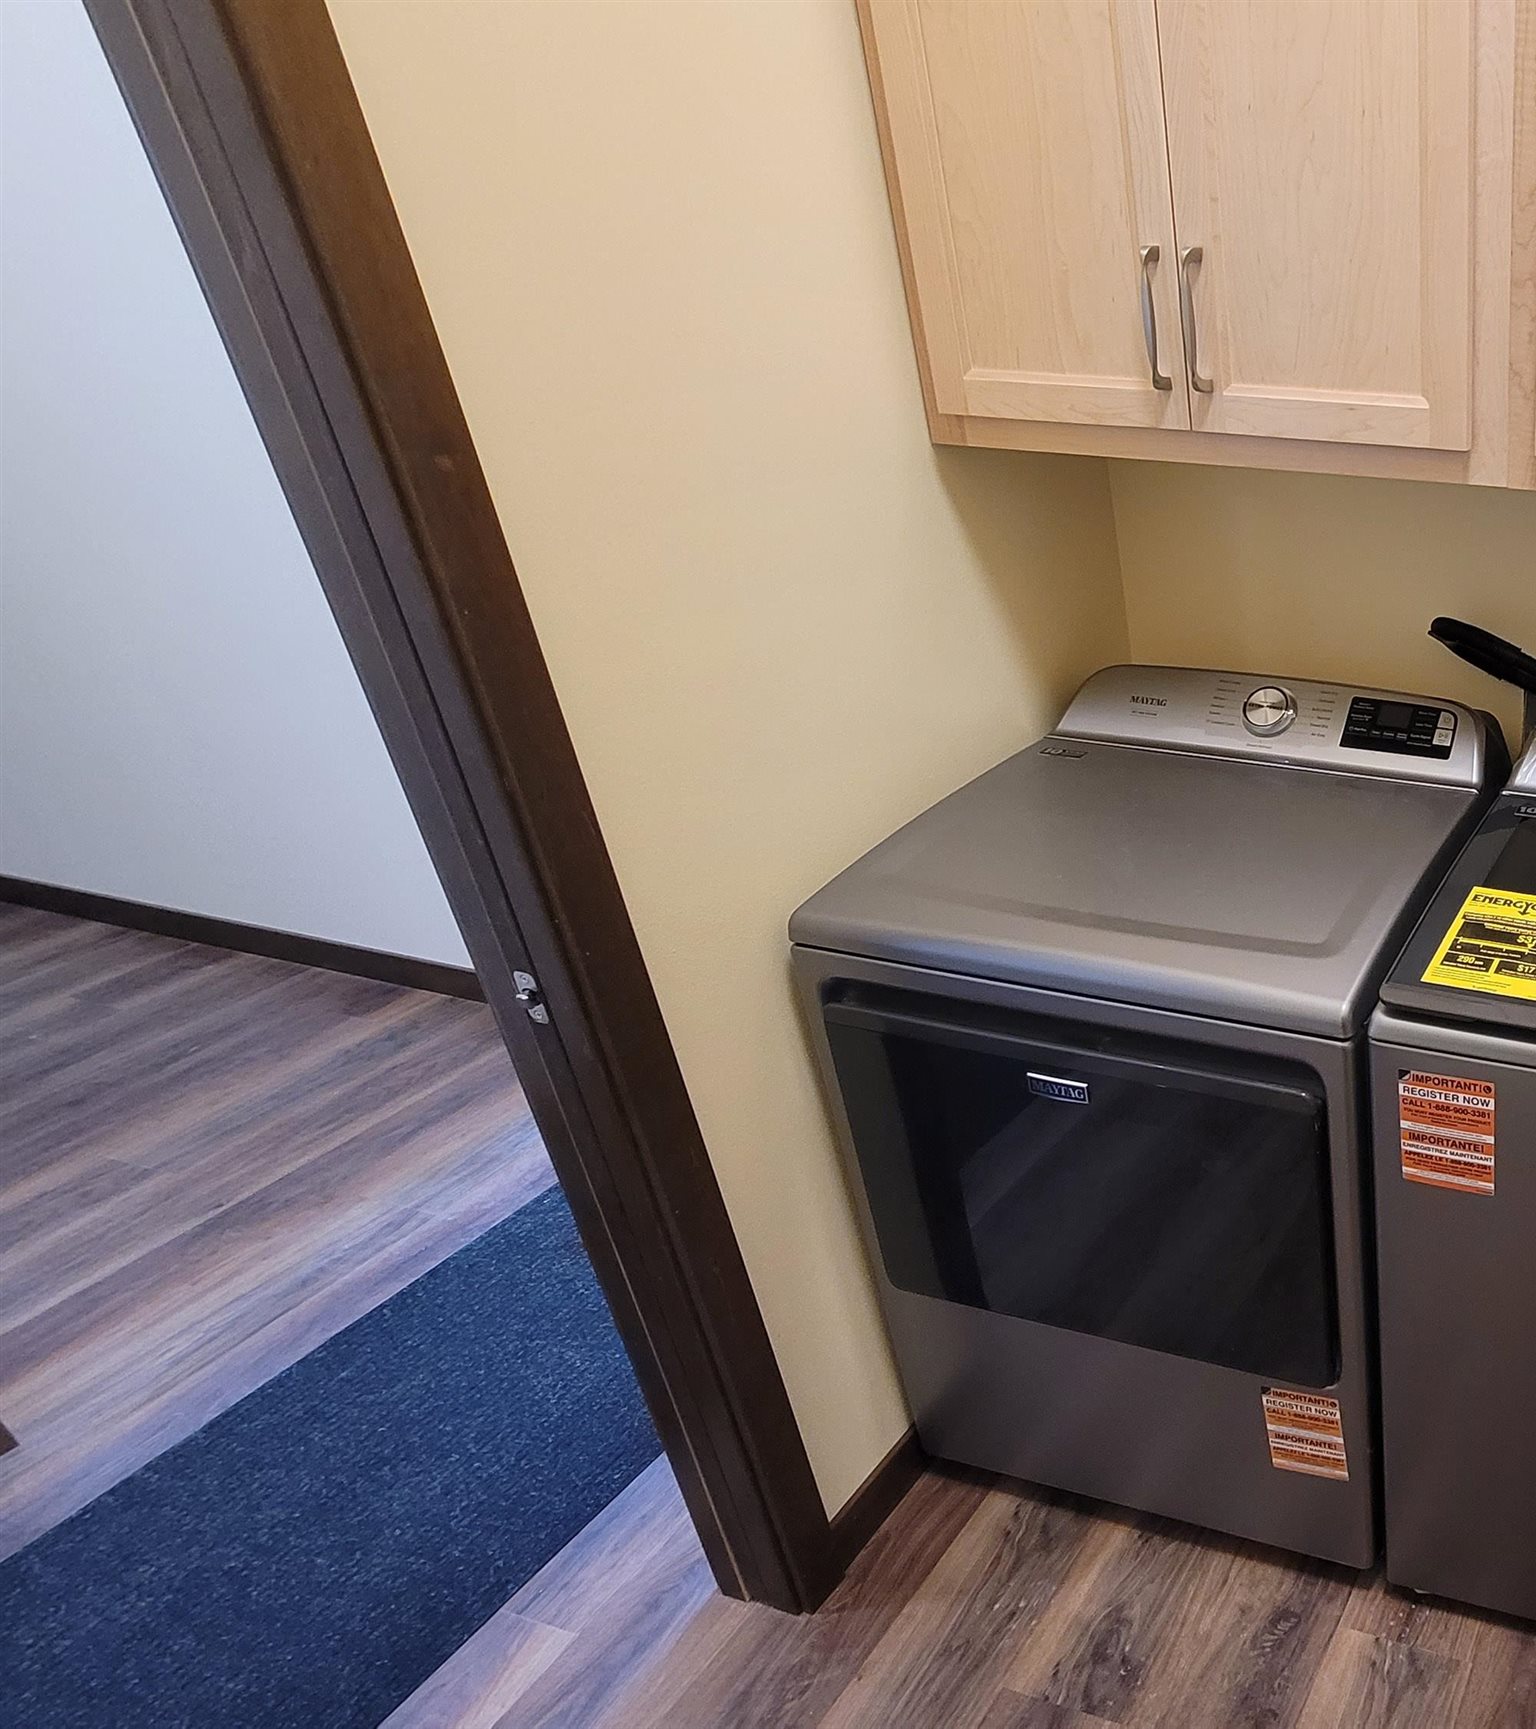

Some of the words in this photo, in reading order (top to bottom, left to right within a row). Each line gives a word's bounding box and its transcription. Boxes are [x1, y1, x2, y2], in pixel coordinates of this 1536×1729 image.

[1130, 695, 1167, 707] MAYTAG
[1456, 955, 1476, 964] 290
[1032, 1080, 1084, 1099] MAYTAG
[1412, 1073, 1482, 1092] IMPORTANT!
[1402, 1086, 1460, 1103] REGISTER
[1463, 1095, 1491, 1108] NOW
[1402, 1098, 1425, 1108] CALL
[1408, 1132, 1484, 1153] IMPORTANTE!
[1402, 1142, 1448, 1155] ENREGISTREZ
[1449, 1151, 1493, 1162] MAINTENANT
[1272, 1389, 1329, 1407] IMPORTANT!
[1266, 1398, 1313, 1413] REGISTER
[1314, 1407, 1337, 1418] NOW
[1266, 1407, 1286, 1416] CALL
[1275, 1433, 1337, 1450] IMPORTANTE!
